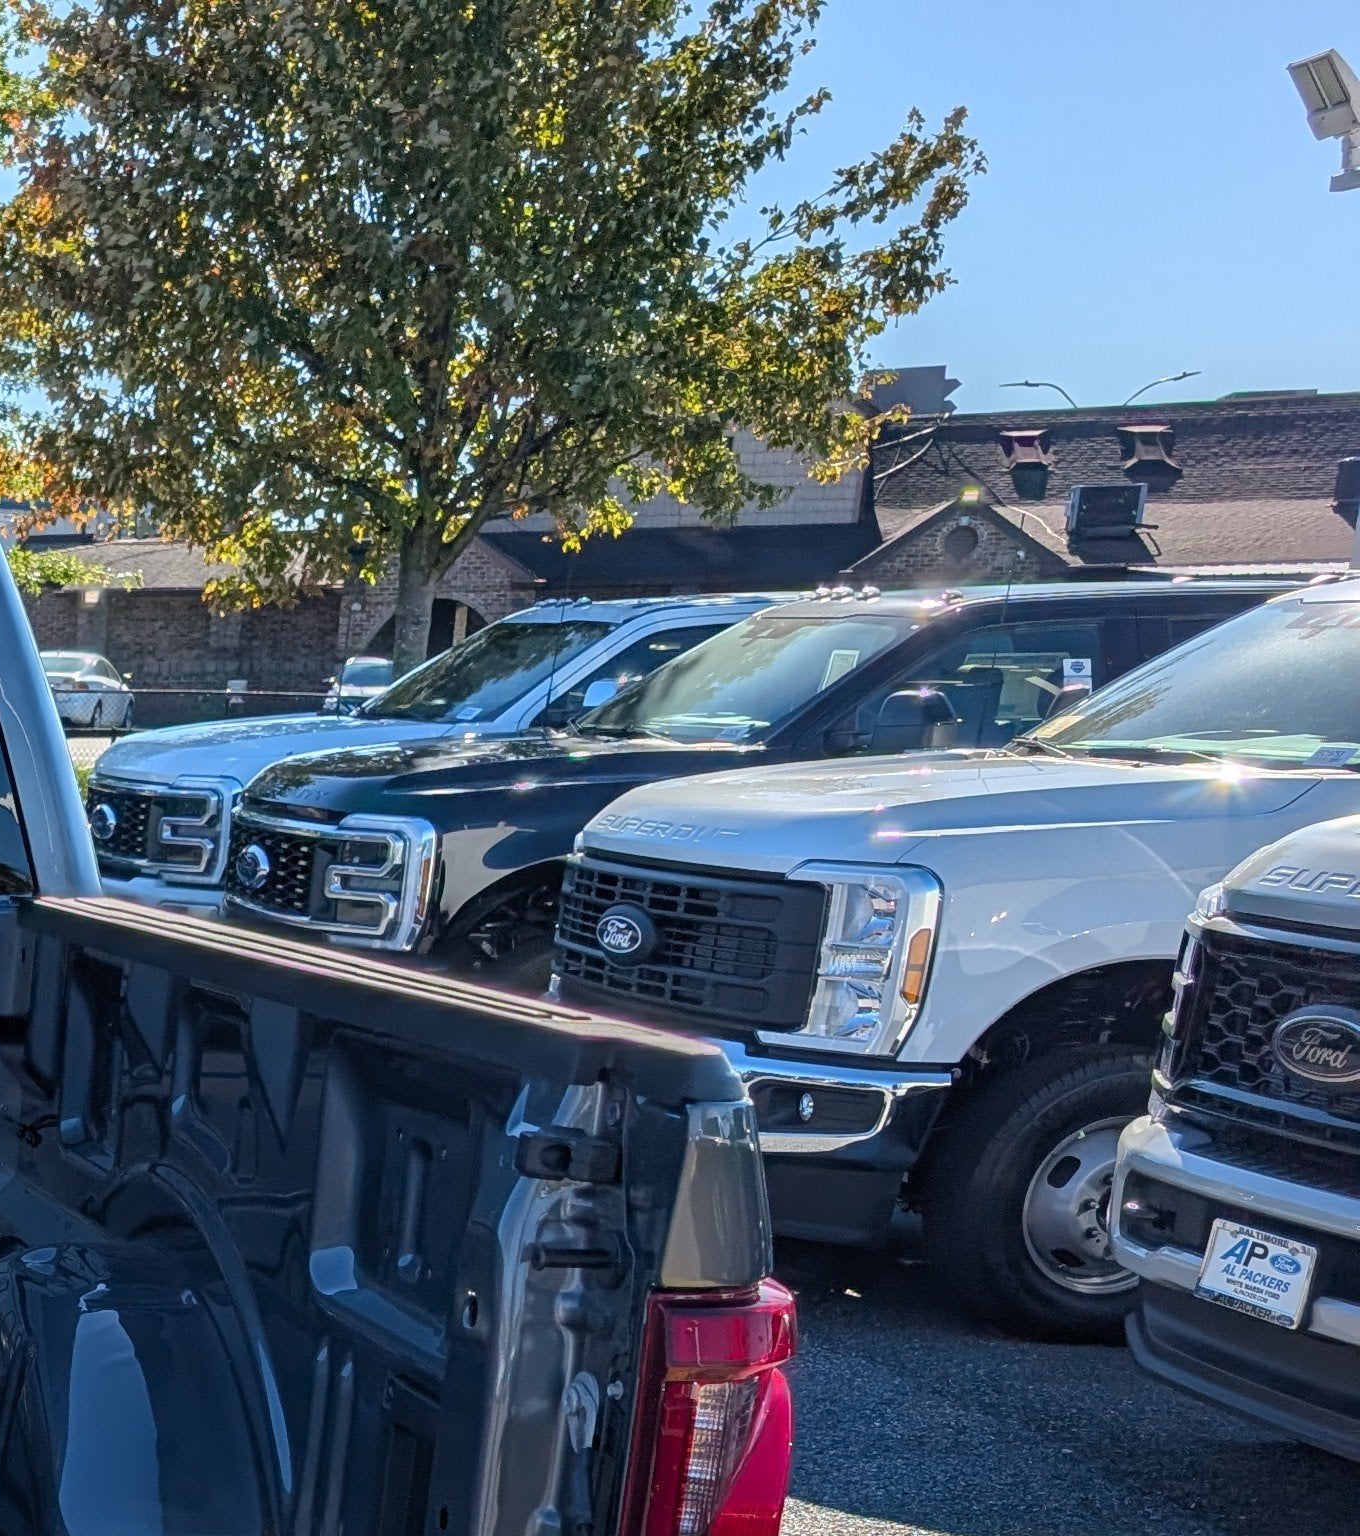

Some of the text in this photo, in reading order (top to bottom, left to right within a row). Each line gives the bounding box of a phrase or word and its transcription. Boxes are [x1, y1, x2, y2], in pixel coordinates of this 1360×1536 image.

[597, 813, 674, 838] SUPER
[603, 919, 634, 947] Ford
[1292, 1027, 1354, 1069] Ford
[1220, 1238, 1269, 1267] AP
[1221, 1263, 1291, 1293] AL PACKERS
